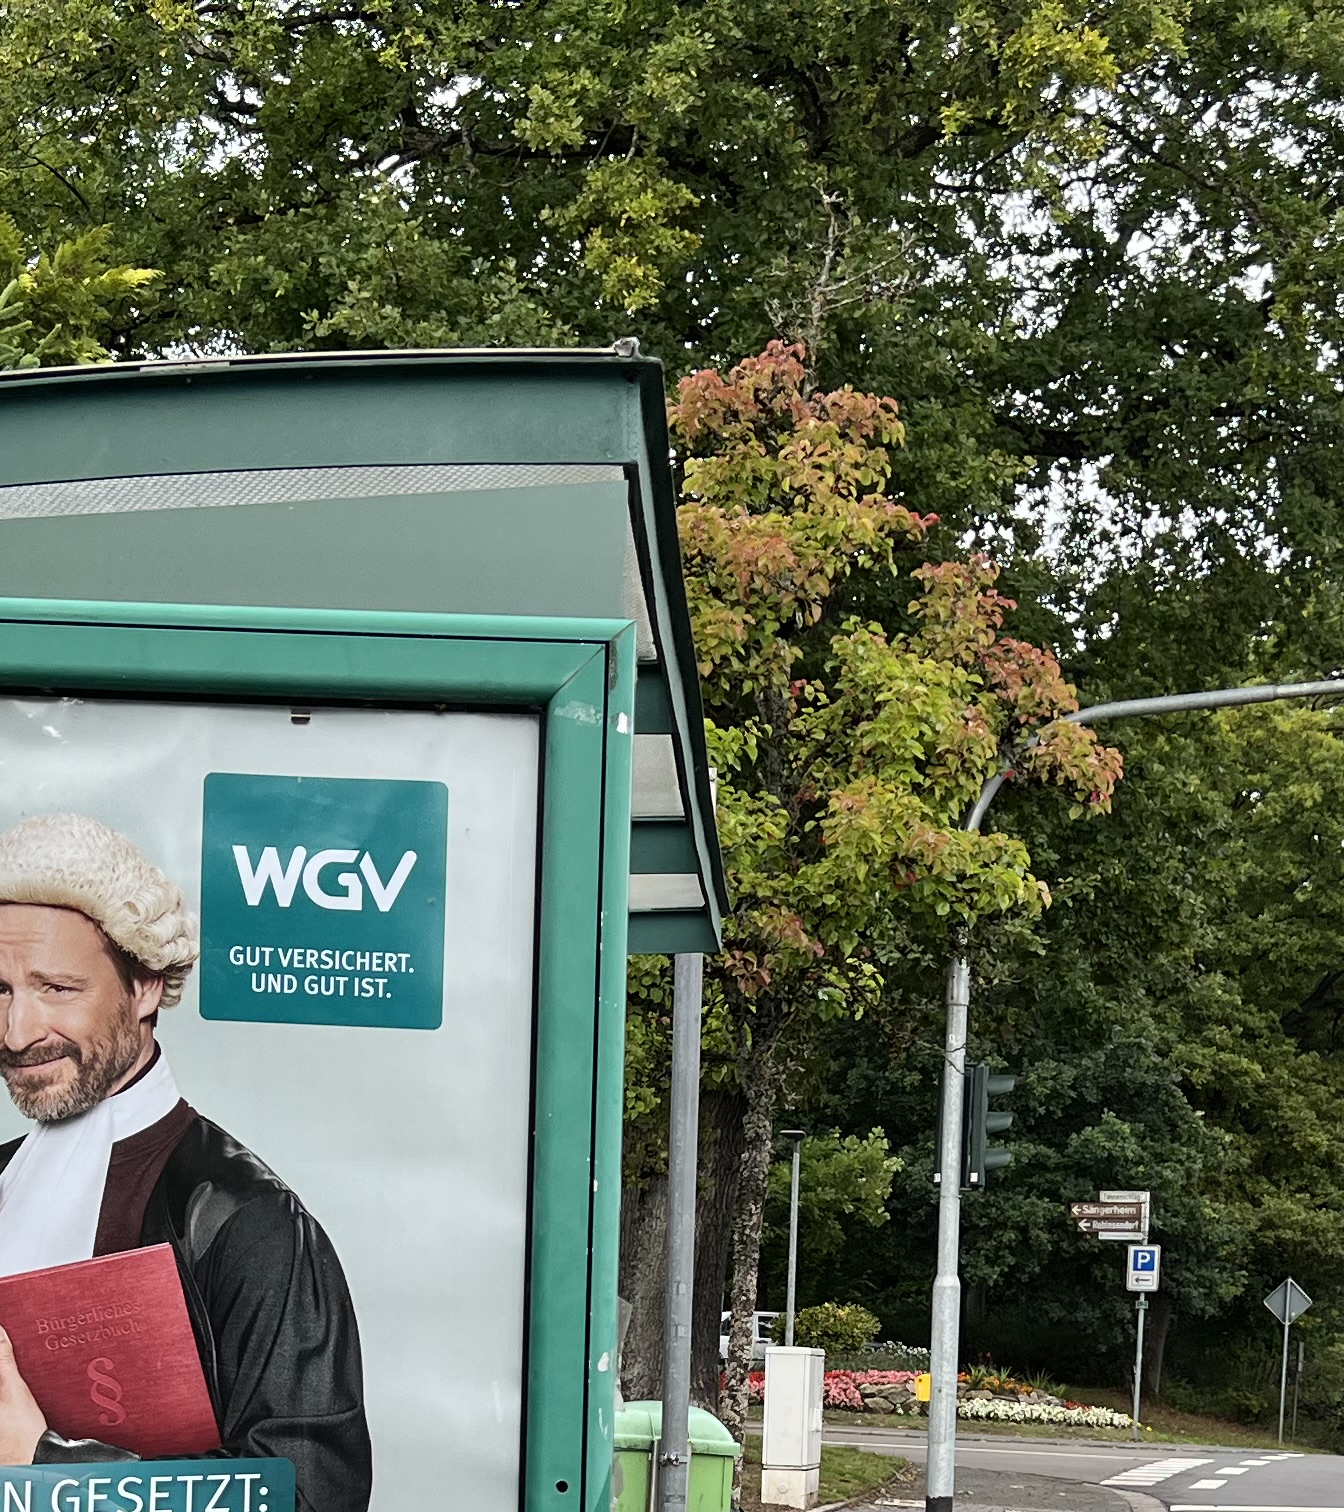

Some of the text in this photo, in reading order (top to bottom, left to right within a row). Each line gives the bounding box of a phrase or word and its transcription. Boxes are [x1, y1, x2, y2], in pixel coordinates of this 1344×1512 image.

[232, 845, 417, 912] WGV
[229, 945, 414, 974] GUT VERSICHERT.
[251, 973, 392, 998] UND GUT IST.
[1137, 1252, 1150, 1269] P
[36, 1300, 142, 1335] Bürgerliches
[45, 1319, 142, 1351] Gesetzbuch
